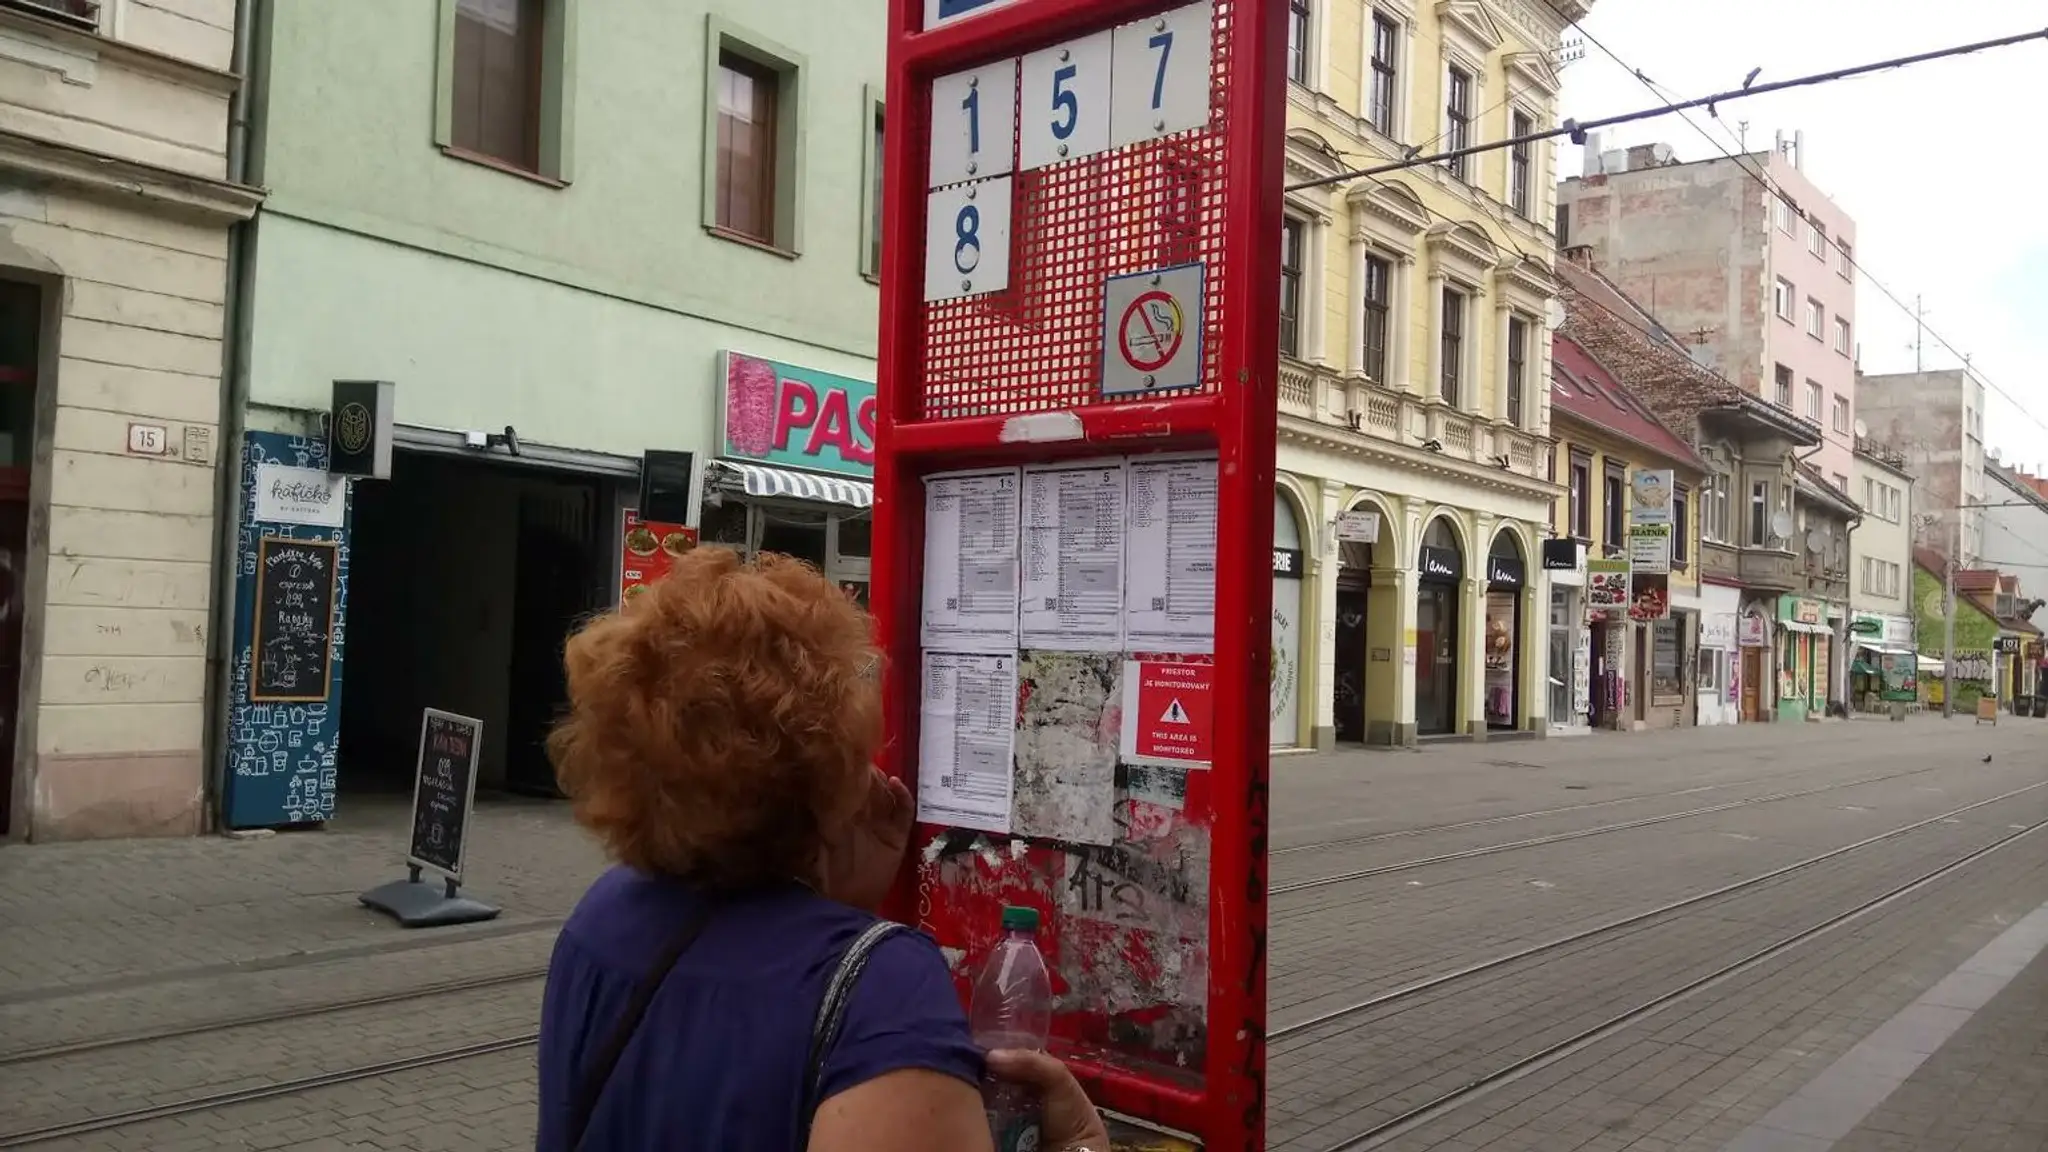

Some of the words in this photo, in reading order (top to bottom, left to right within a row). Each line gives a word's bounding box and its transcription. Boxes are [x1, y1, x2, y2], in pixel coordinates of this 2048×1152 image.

[1149, 33, 1173, 109] 7
[1051, 65, 1077, 140] 5
[962, 87, 979, 154] 1
[955, 205, 980, 274] 8
[140, 430, 155, 447] 15
[1103, 472, 1110, 483] 5
[996, 659, 1003, 670] 8
[1161, 668, 1196, 676] PRIESTOR
[1152, 731, 1168, 740] THIS
[1169, 733, 1188, 742] AREA
[1189, 734, 1198, 743] IS
[1153, 744, 1195, 755] MONITORED
